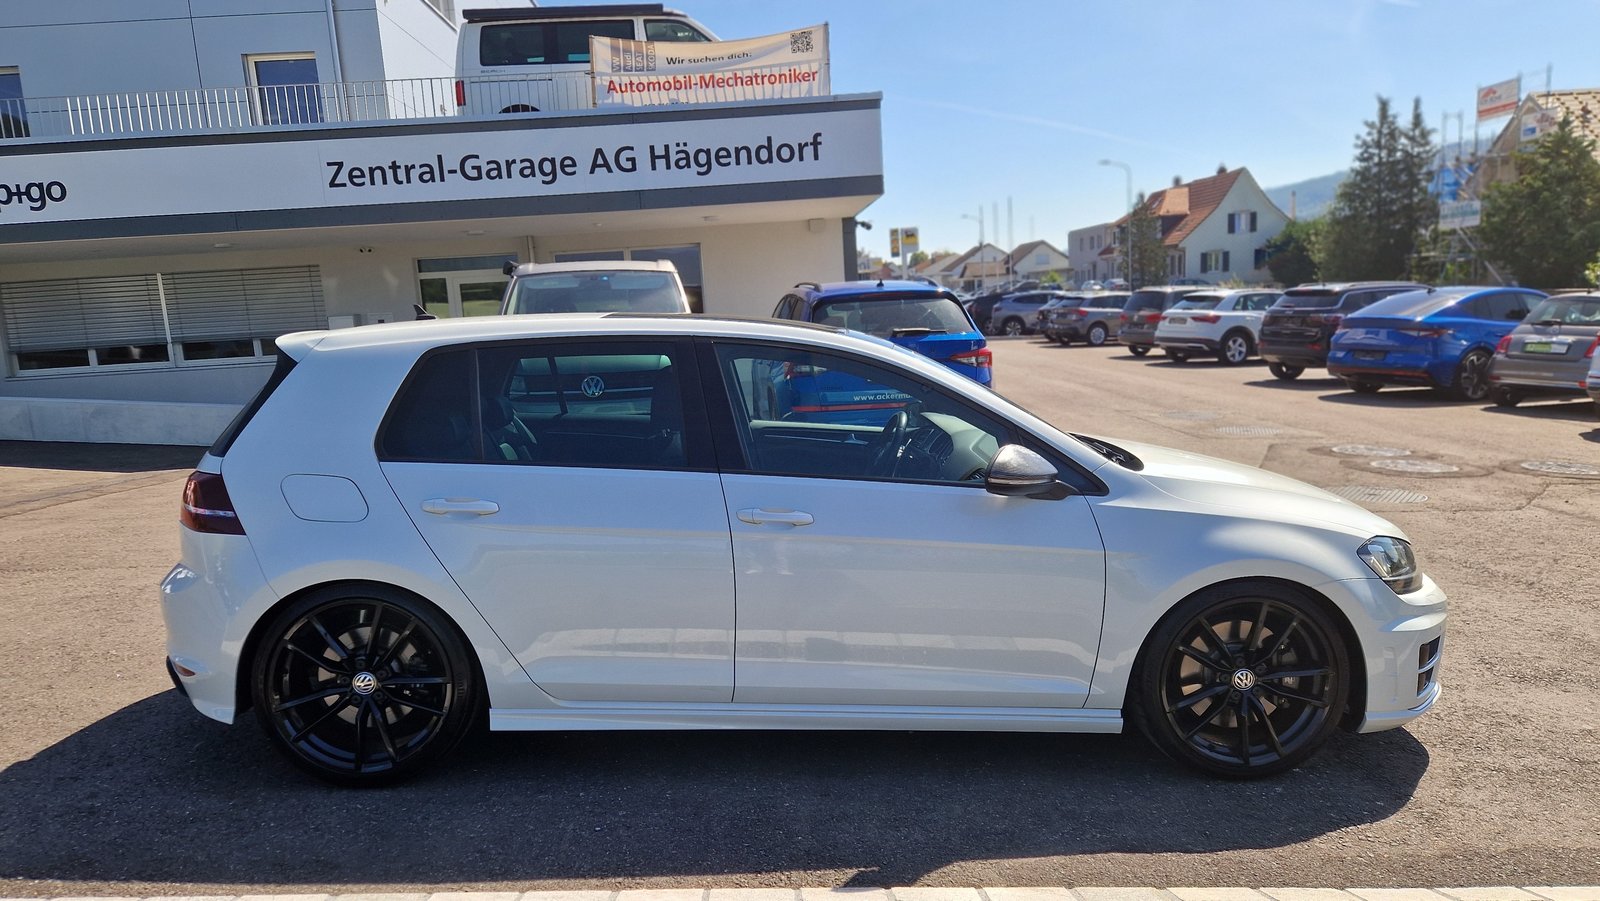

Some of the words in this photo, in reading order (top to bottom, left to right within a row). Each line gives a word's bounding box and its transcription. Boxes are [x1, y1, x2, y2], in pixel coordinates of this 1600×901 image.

[624, 52, 632, 70] Audi
[635, 52, 643, 70] SEAT
[666, 56, 684, 65] Wir
[687, 55, 724, 64] suchen
[607, 68, 818, 94] Automobil-Mechatroniker
[326, 154, 578, 189] Zentral-Garage
[589, 145, 637, 175] AG
[650, 132, 823, 177] Hägendorf
